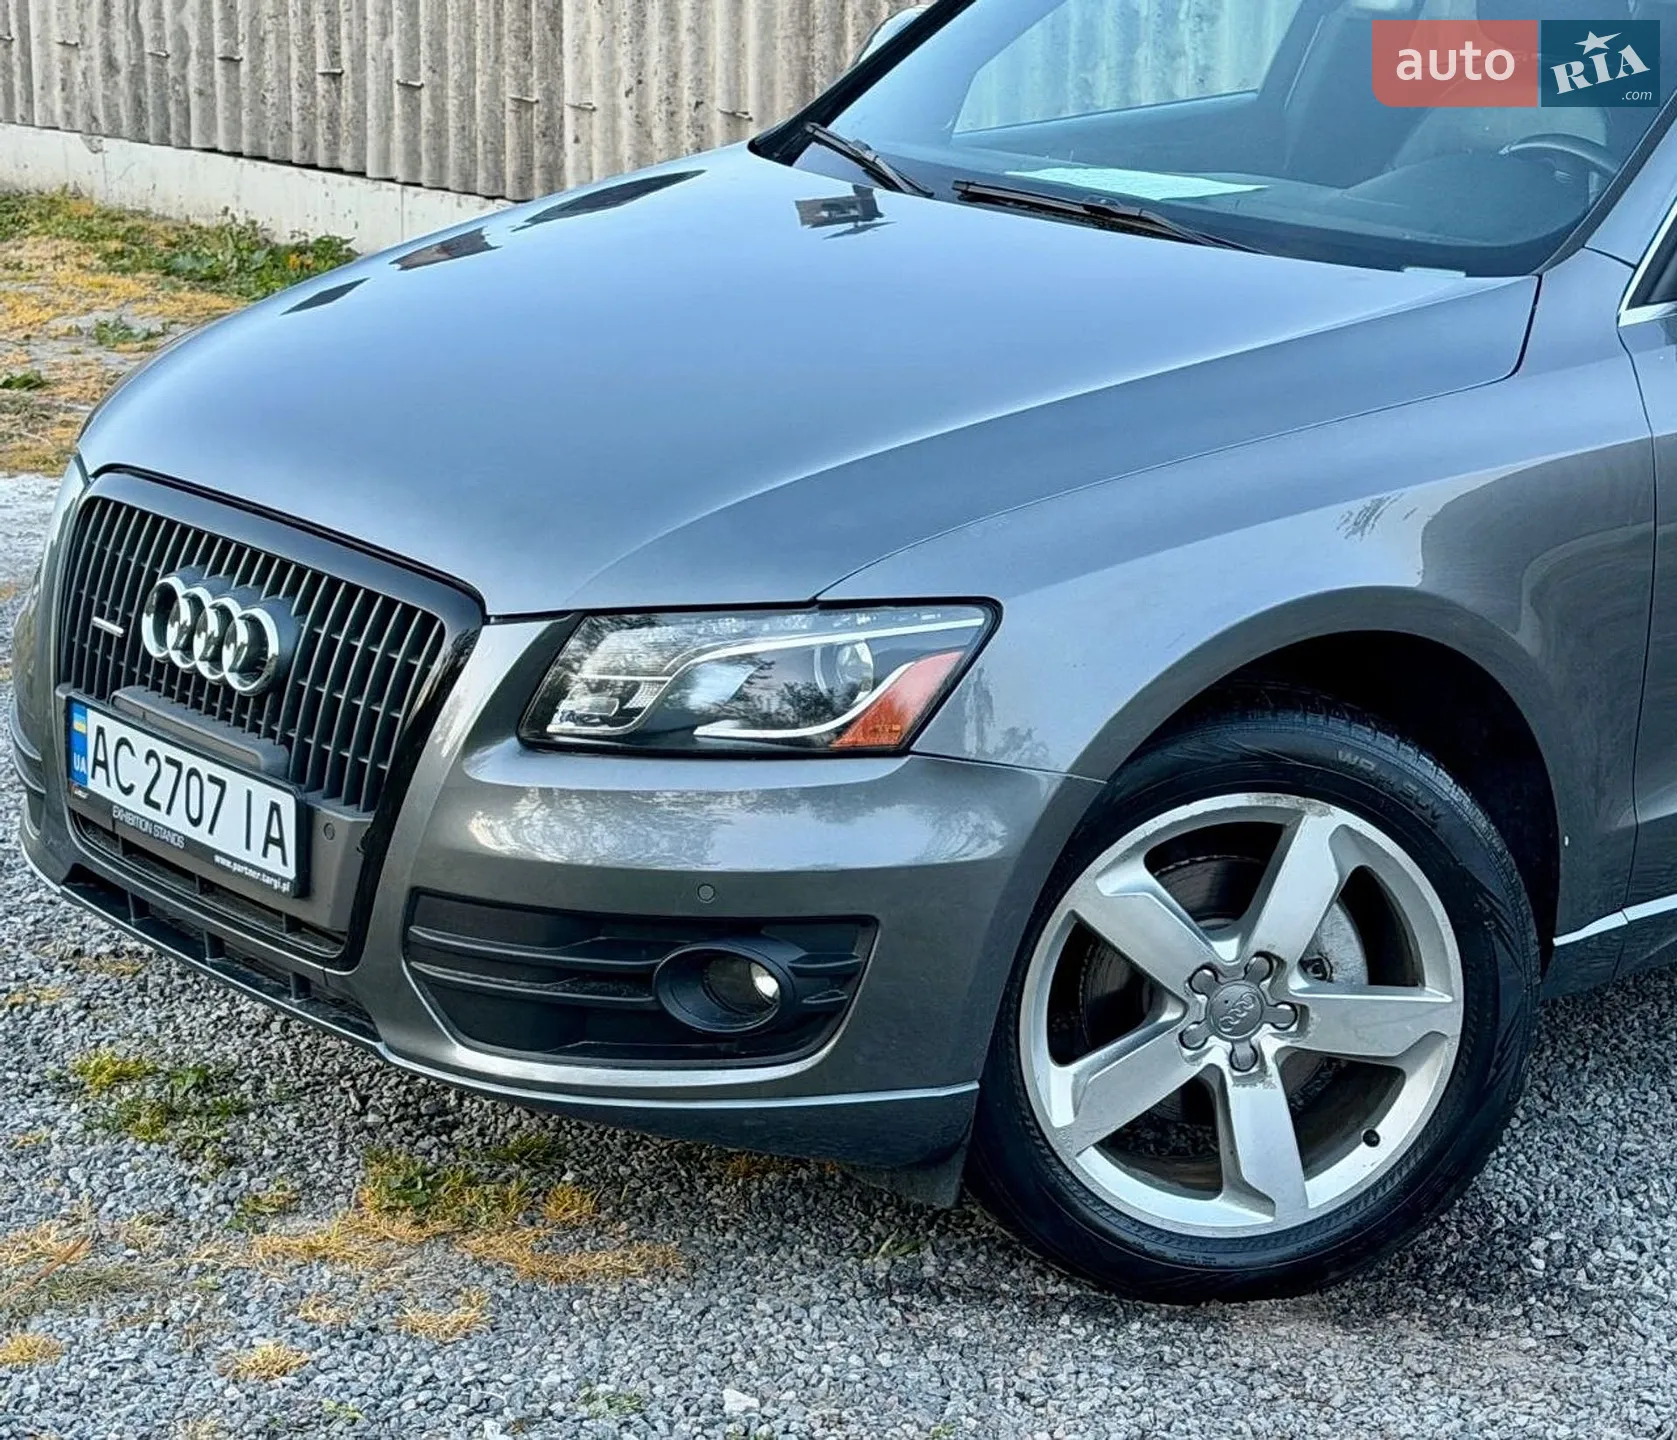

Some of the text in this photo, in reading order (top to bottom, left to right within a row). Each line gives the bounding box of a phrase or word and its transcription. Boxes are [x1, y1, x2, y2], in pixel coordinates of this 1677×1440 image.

[73, 751, 87, 775] UA
[91, 725, 289, 867] AC 2707 IA
[112, 805, 185, 849] EXHIBITION STANDS
